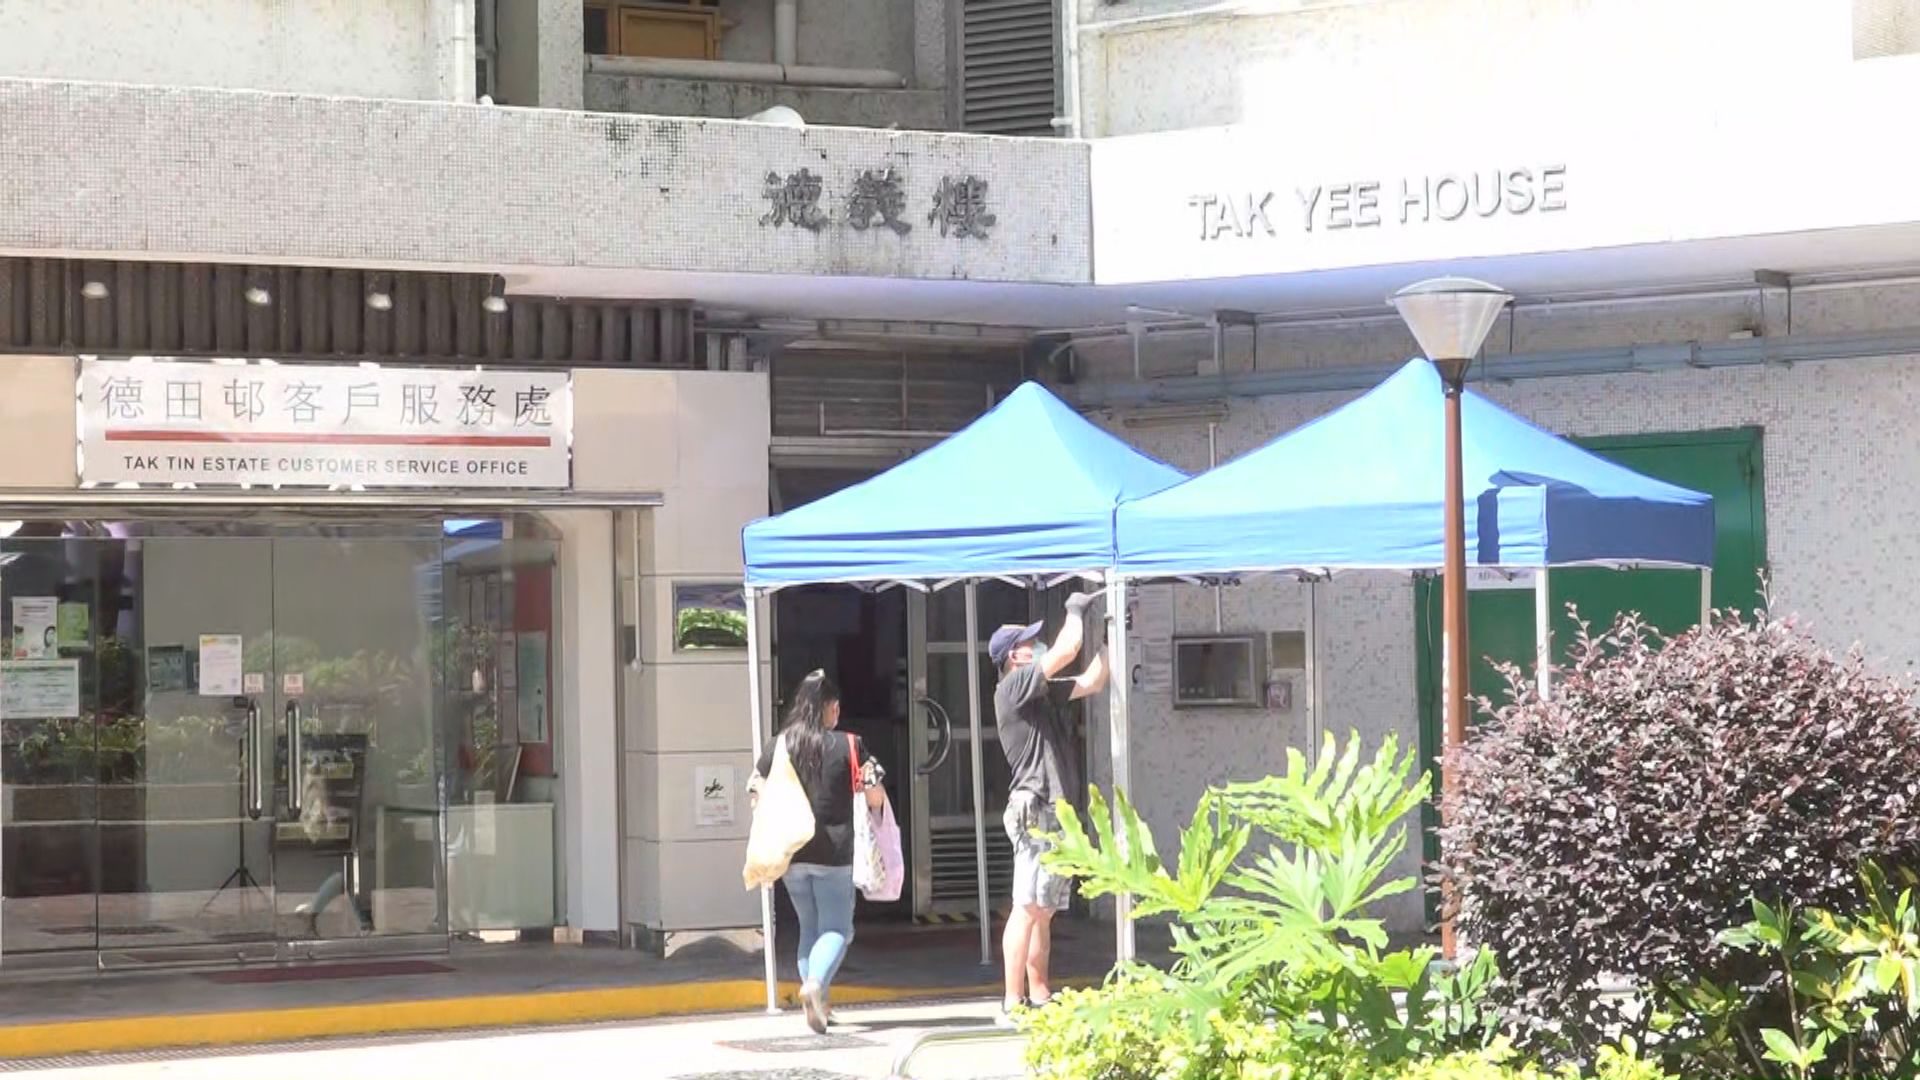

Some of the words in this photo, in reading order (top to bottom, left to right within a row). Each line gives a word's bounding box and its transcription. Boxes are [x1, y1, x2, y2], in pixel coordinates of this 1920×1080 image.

[1188, 191, 1276, 240] TAK
[1296, 181, 1381, 232] YEE
[1399, 164, 1567, 223] HOUSE
[100, 376, 553, 427] 德田邨客戶服務處
[124, 456, 159, 470] TAK
[168, 456, 195, 470] TIN
[203, 457, 271, 471] ESTATE
[278, 458, 377, 473] CUSTOMER
[385, 459, 459, 474] SERVICE
[466, 460, 528, 475] OFFICE
